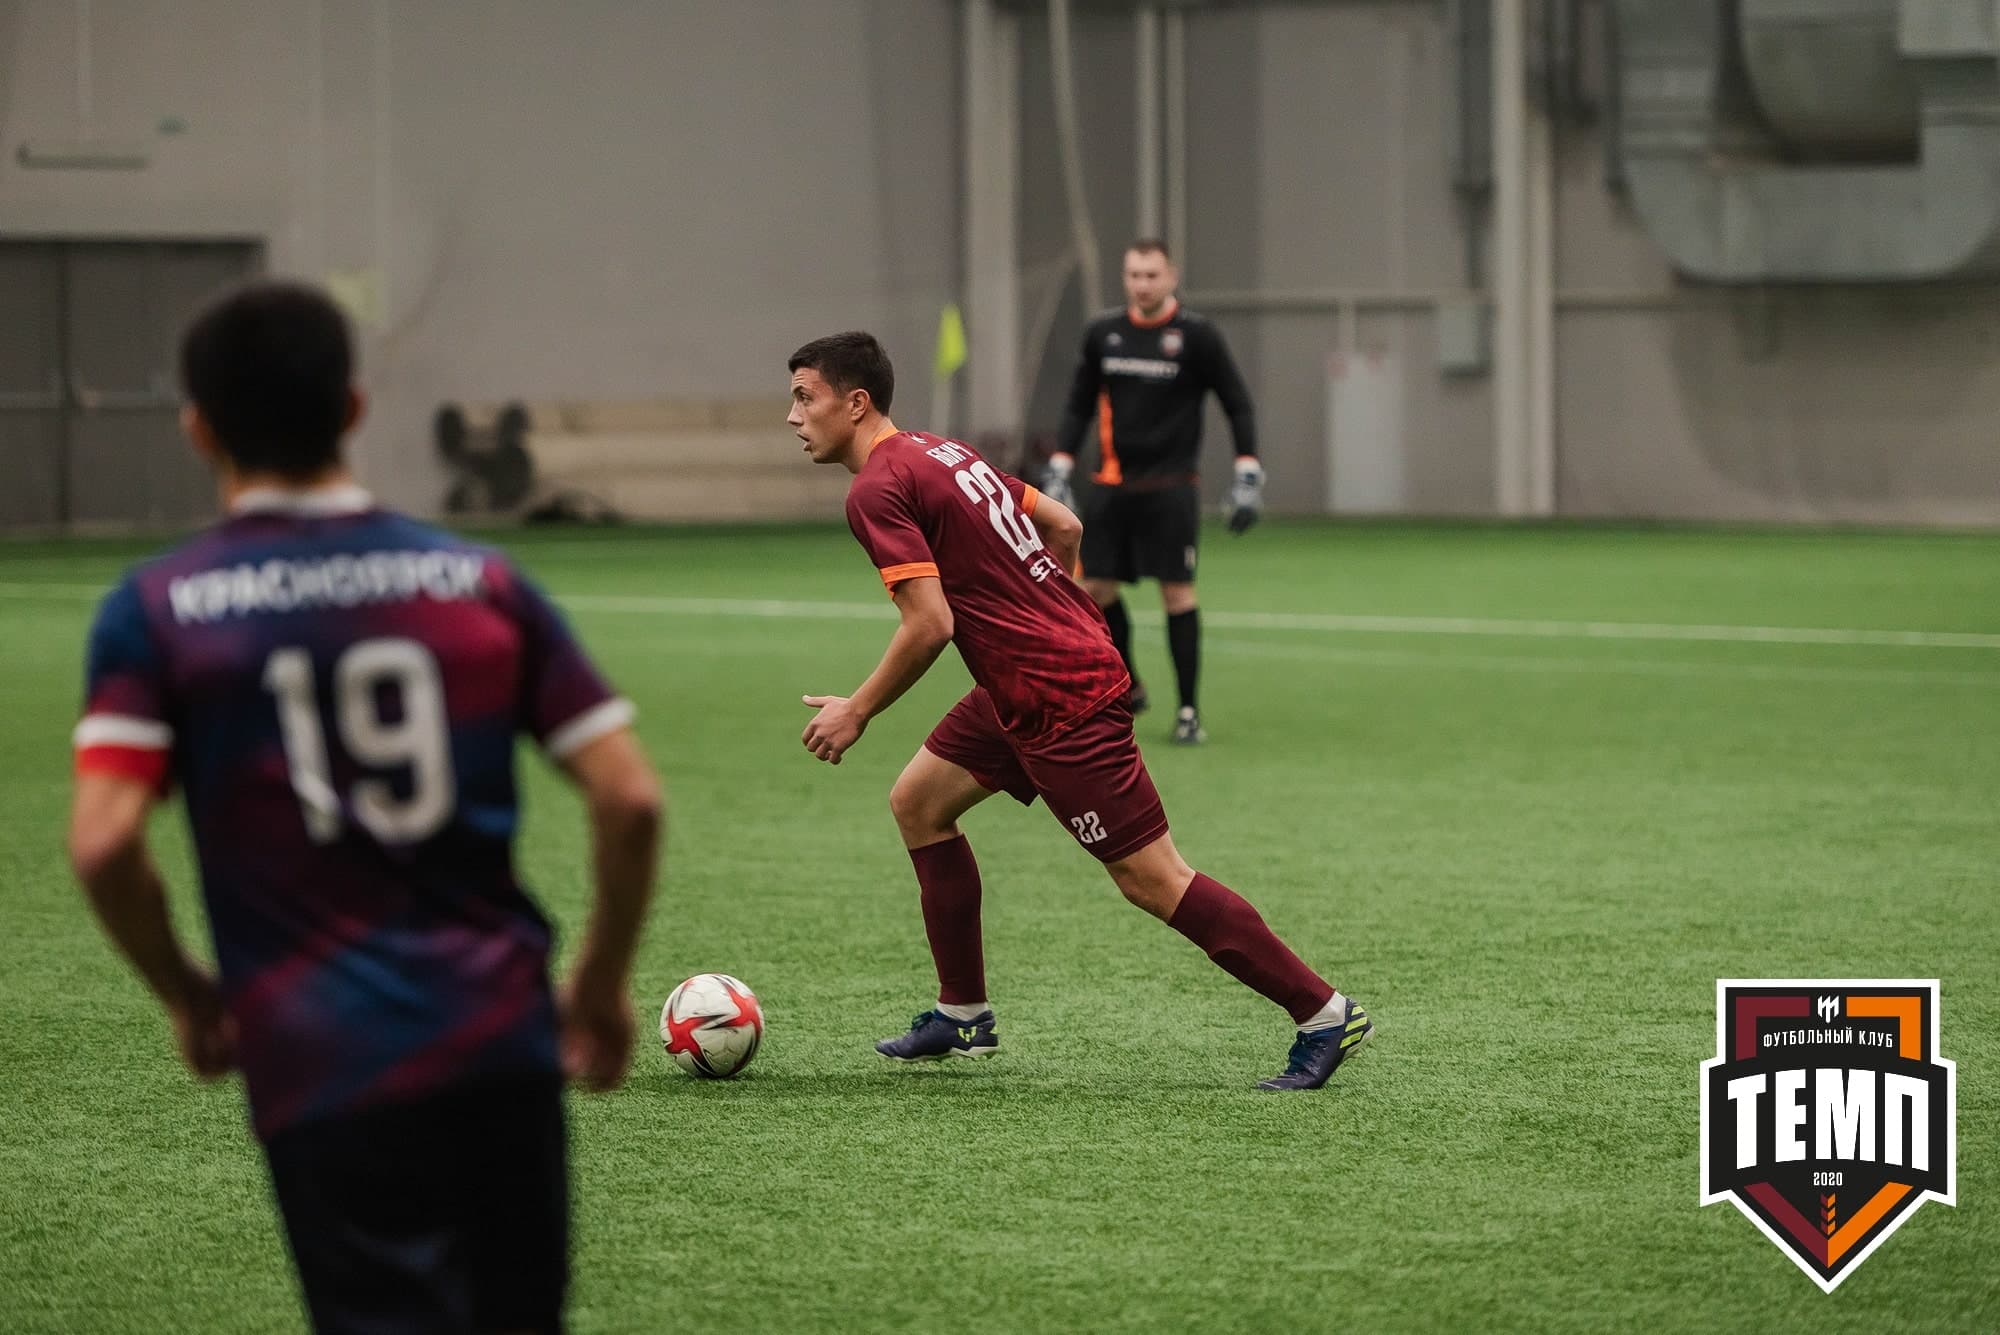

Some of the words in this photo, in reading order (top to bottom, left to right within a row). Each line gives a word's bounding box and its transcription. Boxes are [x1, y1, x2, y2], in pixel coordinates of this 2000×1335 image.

[955, 460, 1044, 562] 22
[261, 637, 456, 845] 19
[1070, 810, 1108, 844] 22
